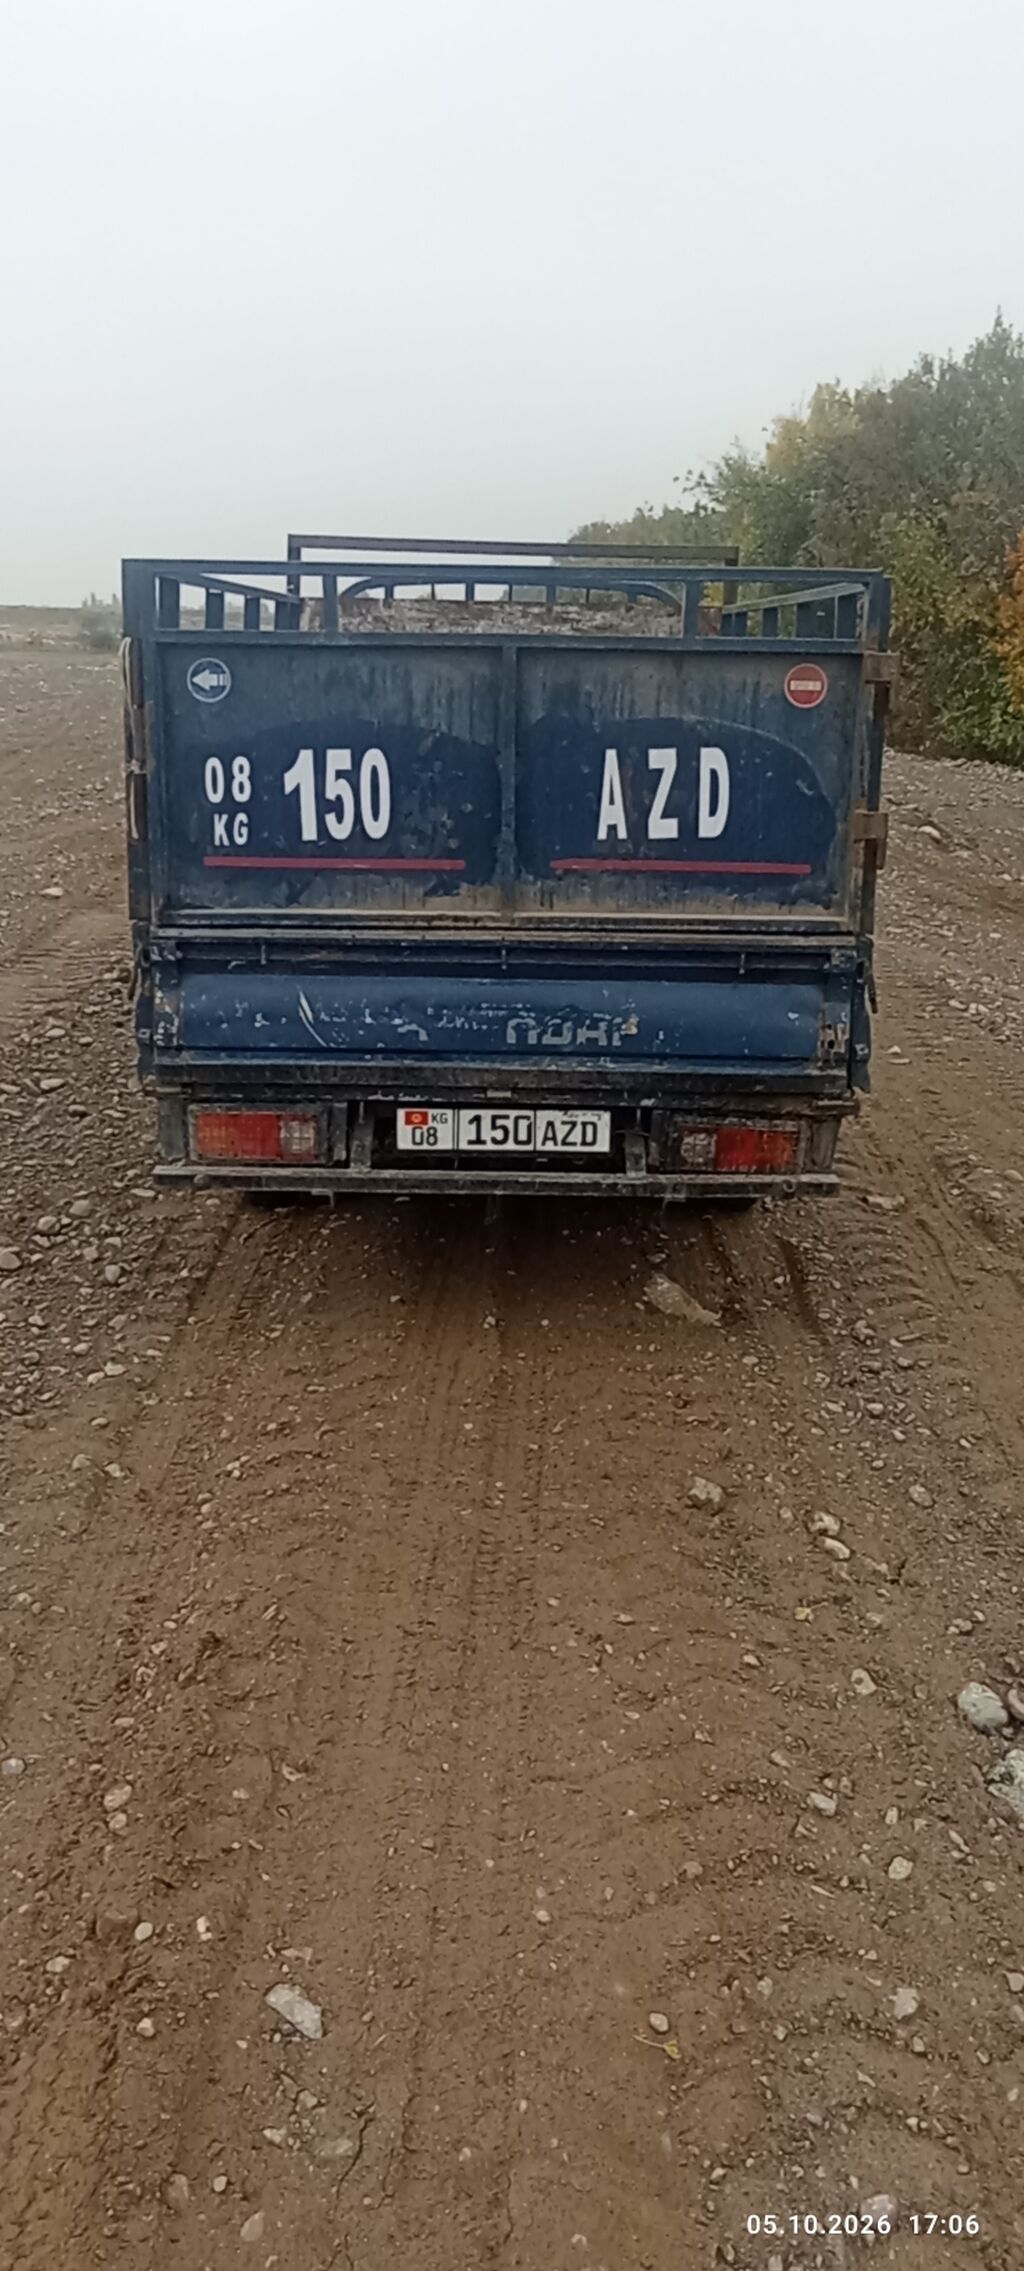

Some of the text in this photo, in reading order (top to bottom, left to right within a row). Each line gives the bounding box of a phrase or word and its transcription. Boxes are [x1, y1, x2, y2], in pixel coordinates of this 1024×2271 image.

[204, 747, 730, 842] 08 150 AZD
[213, 812, 249, 846] KG
[411, 1114, 598, 1147] 08 150 AZD
[431, 1112, 448, 1125] KG
